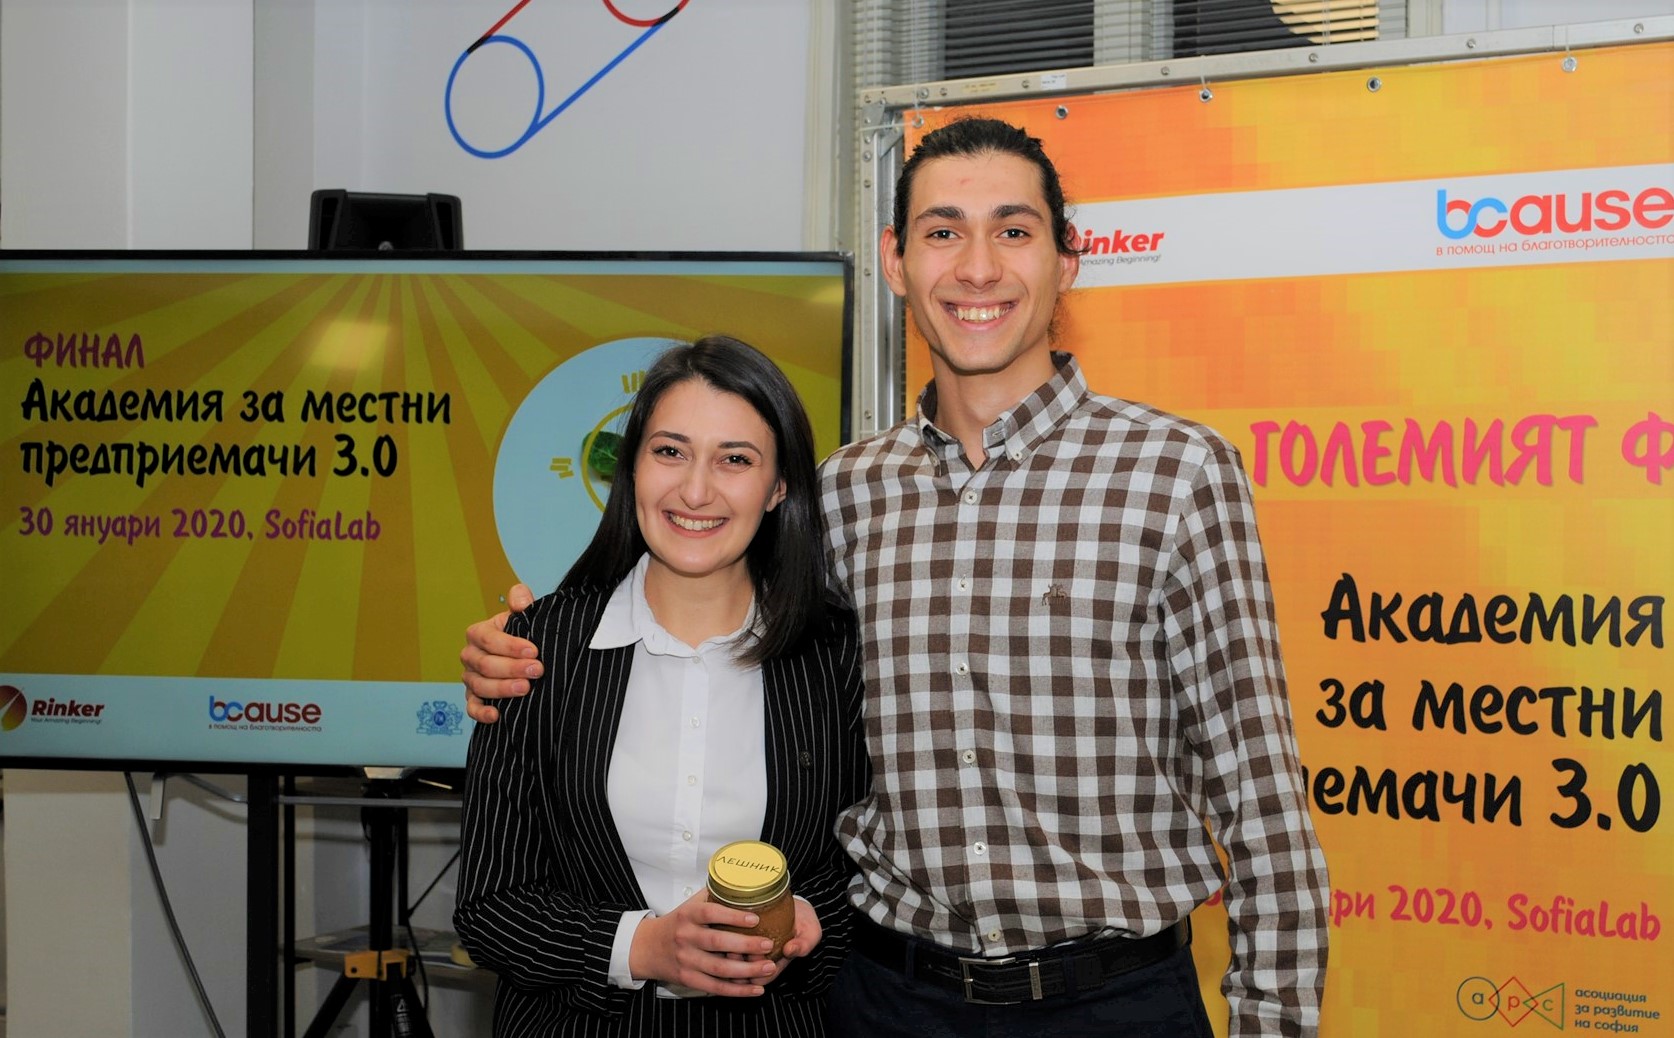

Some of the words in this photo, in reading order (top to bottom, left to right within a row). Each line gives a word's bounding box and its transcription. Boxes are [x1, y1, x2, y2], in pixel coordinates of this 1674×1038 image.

[1437, 187, 1674, 240] bcause
[1082, 229, 1165, 255] inker
[1116, 253, 1162, 265] Beginning!
[1436, 247, 1444, 256] в
[1447, 244, 1495, 256] помощ
[1499, 242, 1518, 253] на
[24, 332, 145, 369] ФИНАЛ
[21, 378, 224, 423] Академия
[240, 390, 285, 423] за
[301, 389, 451, 425] местни
[20, 440, 317, 488] предприемачи
[333, 434, 398, 478] 3.0
[1250, 413, 1599, 488] ГОЛЕМИЯТ
[19, 507, 53, 537] 30
[64, 512, 161, 546] януари
[172, 508, 254, 542] 2020,
[265, 510, 381, 541] SofiaLab
[1320, 572, 1665, 649] Академия
[31, 698, 105, 717] Rinker
[208, 695, 322, 724] bcause
[1315, 678, 1388, 732] за
[1412, 679, 1663, 742] местни
[1549, 757, 1661, 834] 3.0
[717, 856, 781, 874] ЛЕШНИК
[1387, 885, 1493, 930] 2020,
[1507, 893, 1661, 942] SofiaLab
[1574, 1004, 1590, 1015] за
[1593, 1004, 1660, 1020] развитие
[1575, 988, 1647, 1004] асоциация
[1574, 1019, 1591, 1029] на
[1594, 1020, 1639, 1033] софия
